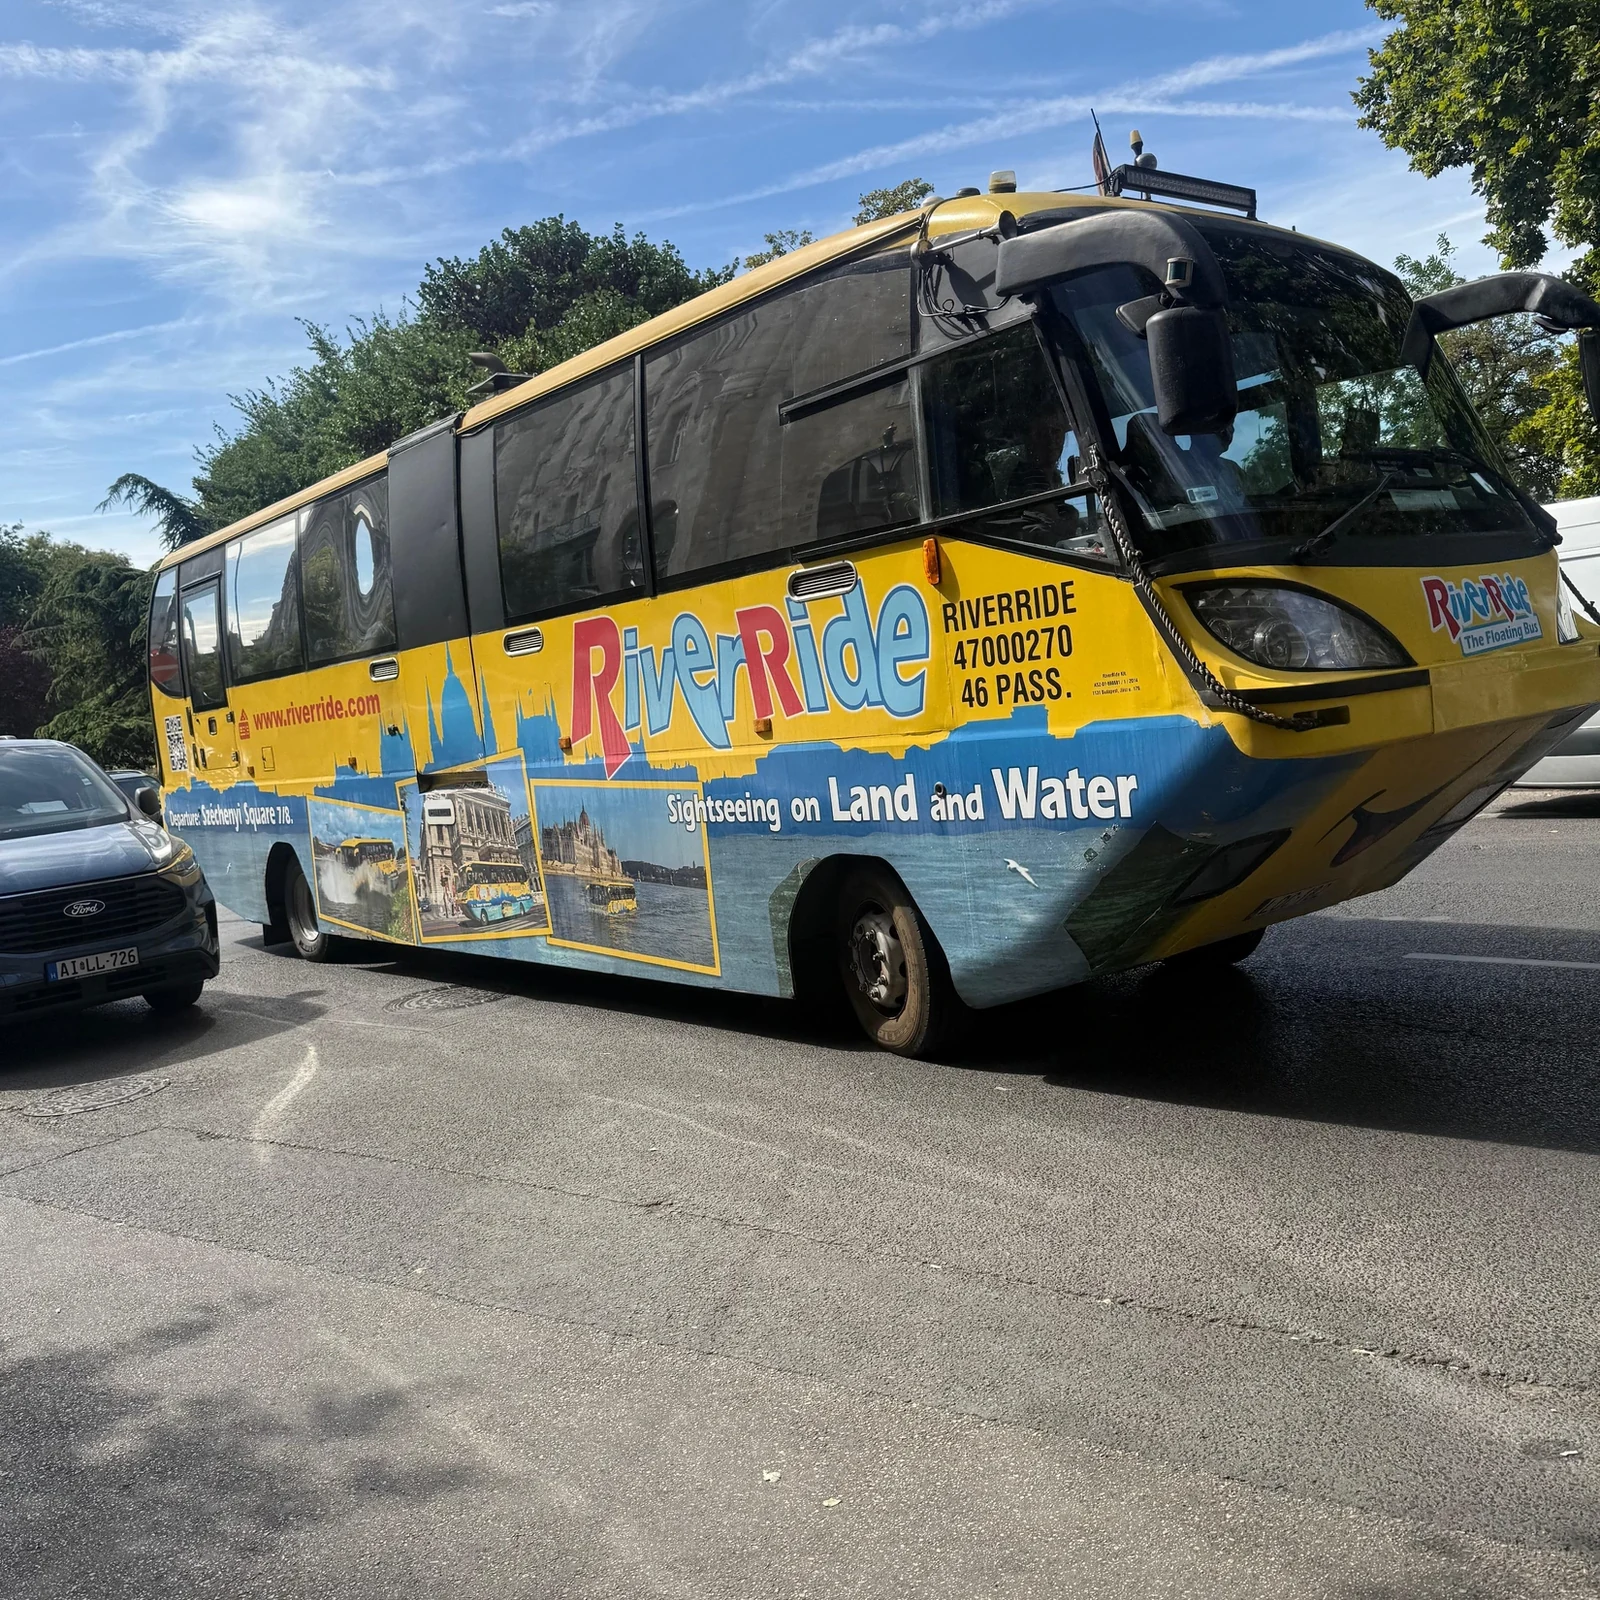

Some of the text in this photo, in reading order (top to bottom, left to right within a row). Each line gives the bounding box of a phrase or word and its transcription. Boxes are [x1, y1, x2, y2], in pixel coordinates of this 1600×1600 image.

[943, 581, 1077, 634] RIVERRIDE
[1420, 573, 1534, 644] RiverRide
[953, 625, 1073, 670] 47000270
[1464, 621, 1539, 649] The Floating Bus
[571, 581, 930, 780] RiverRide
[961, 667, 1072, 708] 46 PASS.
[252, 693, 381, 731] www.riverride.com
[168, 802, 294, 833] Departure: Széchenyi Square 7/8.
[667, 766, 1139, 832] Sightseeing on Land and Water
[71, 902, 98, 915] Ford
